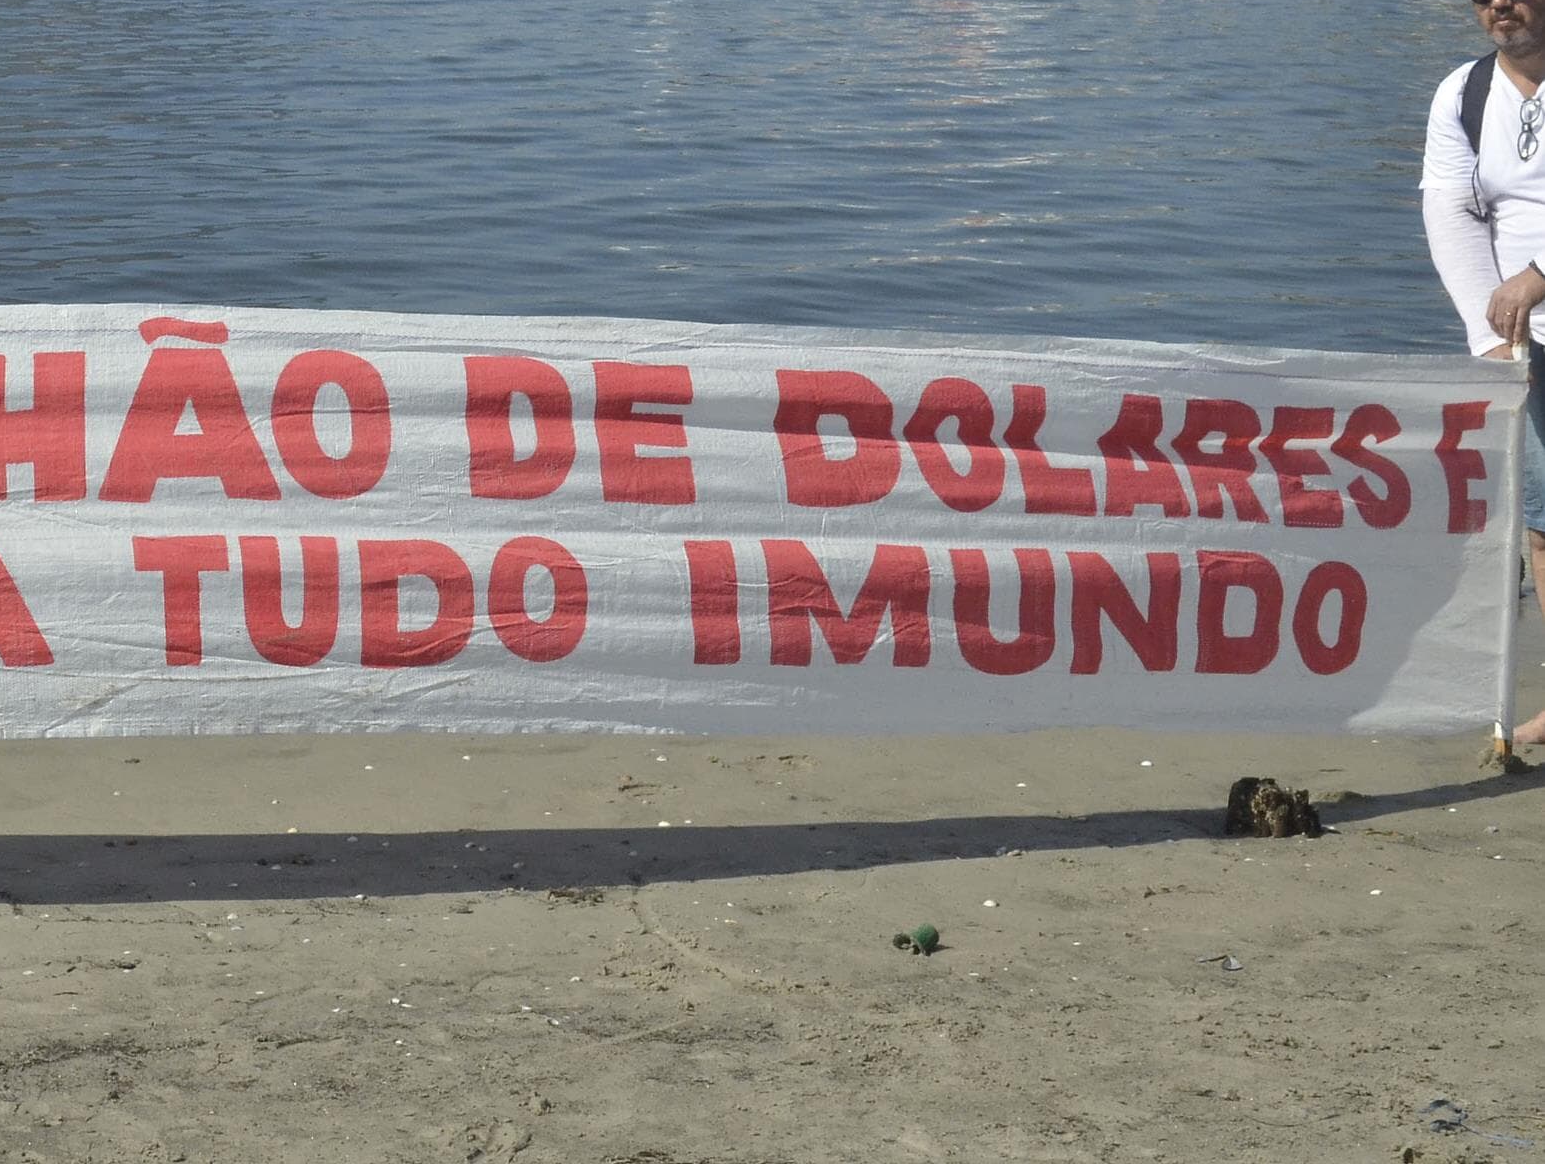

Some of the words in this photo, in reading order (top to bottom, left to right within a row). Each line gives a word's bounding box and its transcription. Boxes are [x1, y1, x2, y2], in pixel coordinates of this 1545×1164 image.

[464, 356, 696, 504] DE
[776, 369, 1409, 527] DOLARES
[1435, 401, 1492, 533] E
[133, 535, 587, 669] TUDO
[685, 539, 1366, 673] IMUNDO
